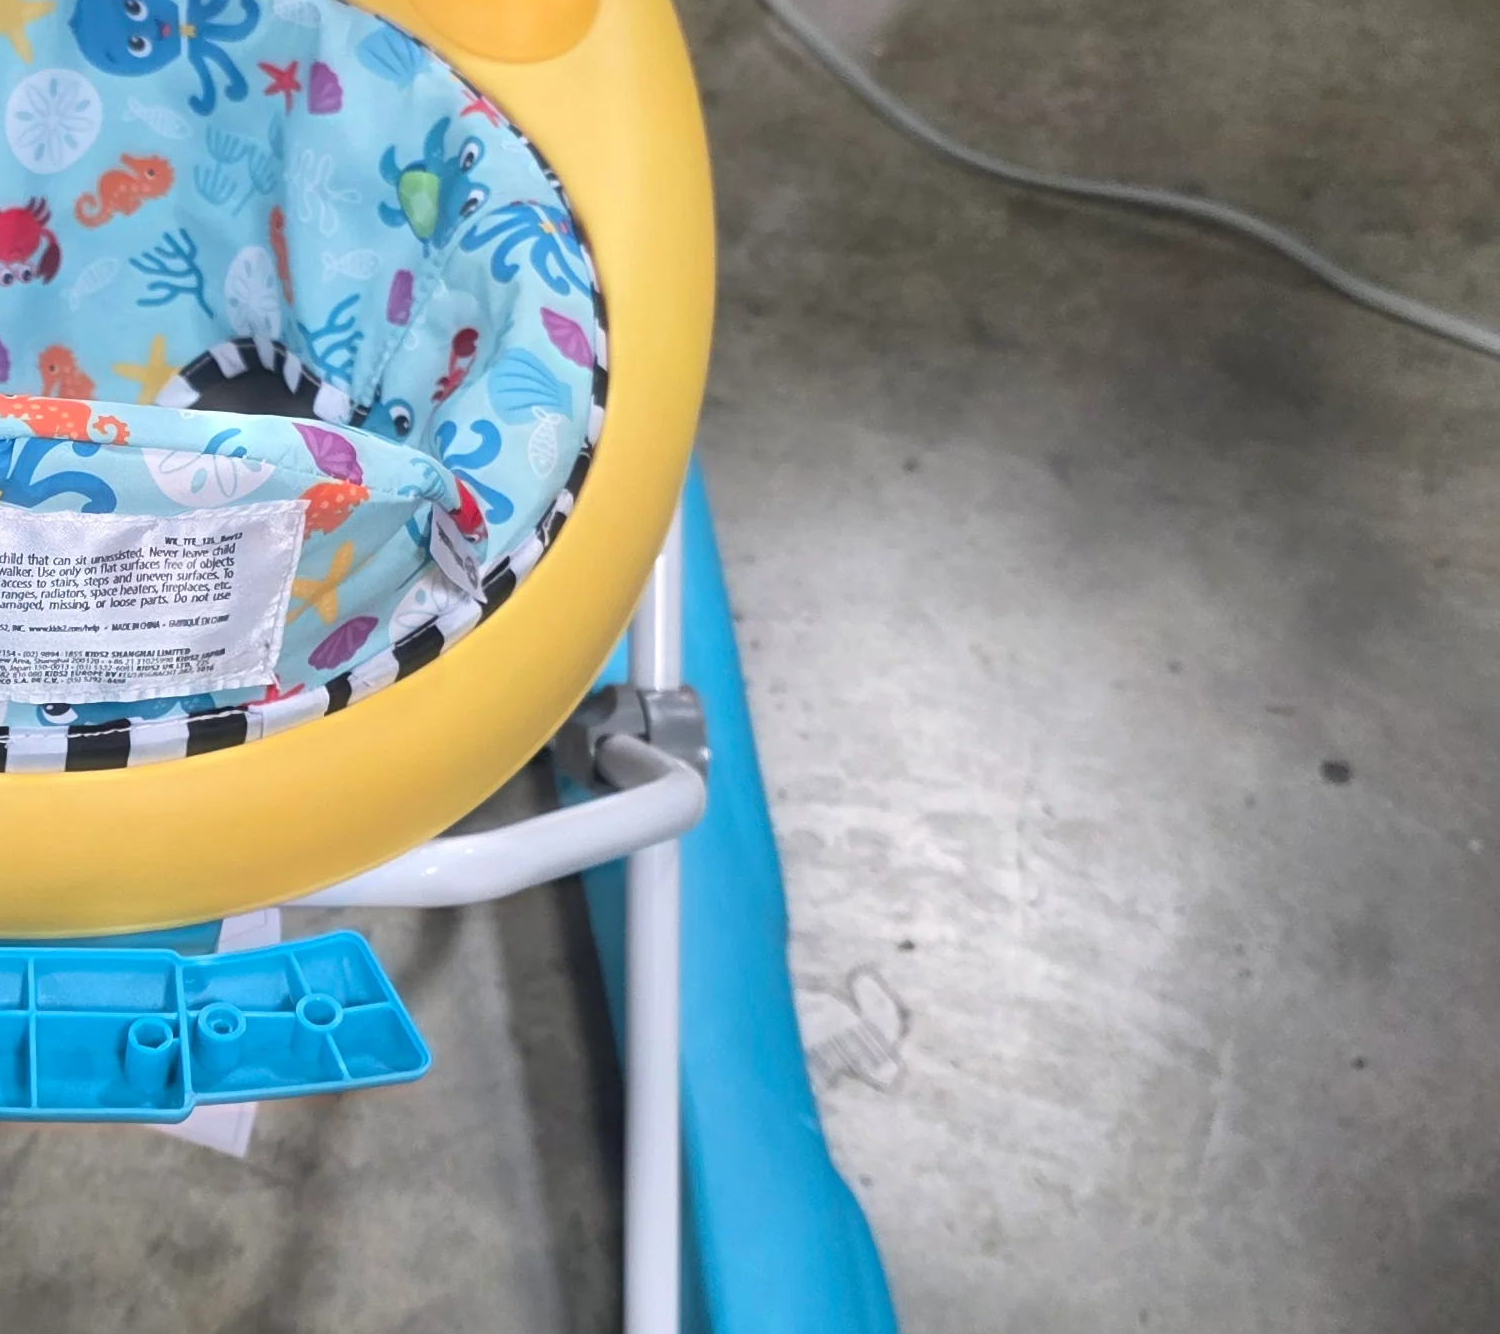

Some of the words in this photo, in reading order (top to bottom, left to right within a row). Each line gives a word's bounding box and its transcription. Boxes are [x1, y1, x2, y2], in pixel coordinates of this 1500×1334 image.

[0, 552, 23, 565] child
[28, 553, 49, 565] that
[53, 557, 71, 565] can
[75, 555, 87, 565] sit
[91, 547, 144, 564] unassisted.
[150, 547, 179, 557] Never
[183, 548, 209, 558] leave
[212, 542, 236, 556] child
[37, 567, 56, 577] Use
[59, 566, 81, 578] only
[84, 567, 97, 575] on
[101, 563, 117, 574] flat
[120, 558, 160, 572] surfaces
[164, 558, 183, 569] free
[186, 558, 197, 569] of
[200, 557, 235, 571] objects
[1, 579, 32, 588] access
[37, 579, 47, 588] to
[51, 577, 79, 588] stairs,
[84, 577, 109, 588] steps
[113, 572, 132, 584] and
[136, 572, 173, 582] uneven
[177, 570, 220, 581] surfaces.
[223, 568, 234, 579] To
[1, 591, 37, 601] ranges,
[41, 588, 87, 599] radiators,
[90, 588, 118, 600] space
[120, 584, 158, 596] heaters,
[162, 582, 210, 594] fireplaces,
[214, 581, 232, 590] etc.
[49, 599, 90, 612] missing,
[96, 600, 106, 608] or
[110, 597, 136, 608] loose
[140, 595, 169, 609] parts.
[174, 593, 187, 603] Do
[191, 593, 209, 603] not
[213, 592, 231, 601] use
[157, 648, 191, 656] LIMITED
